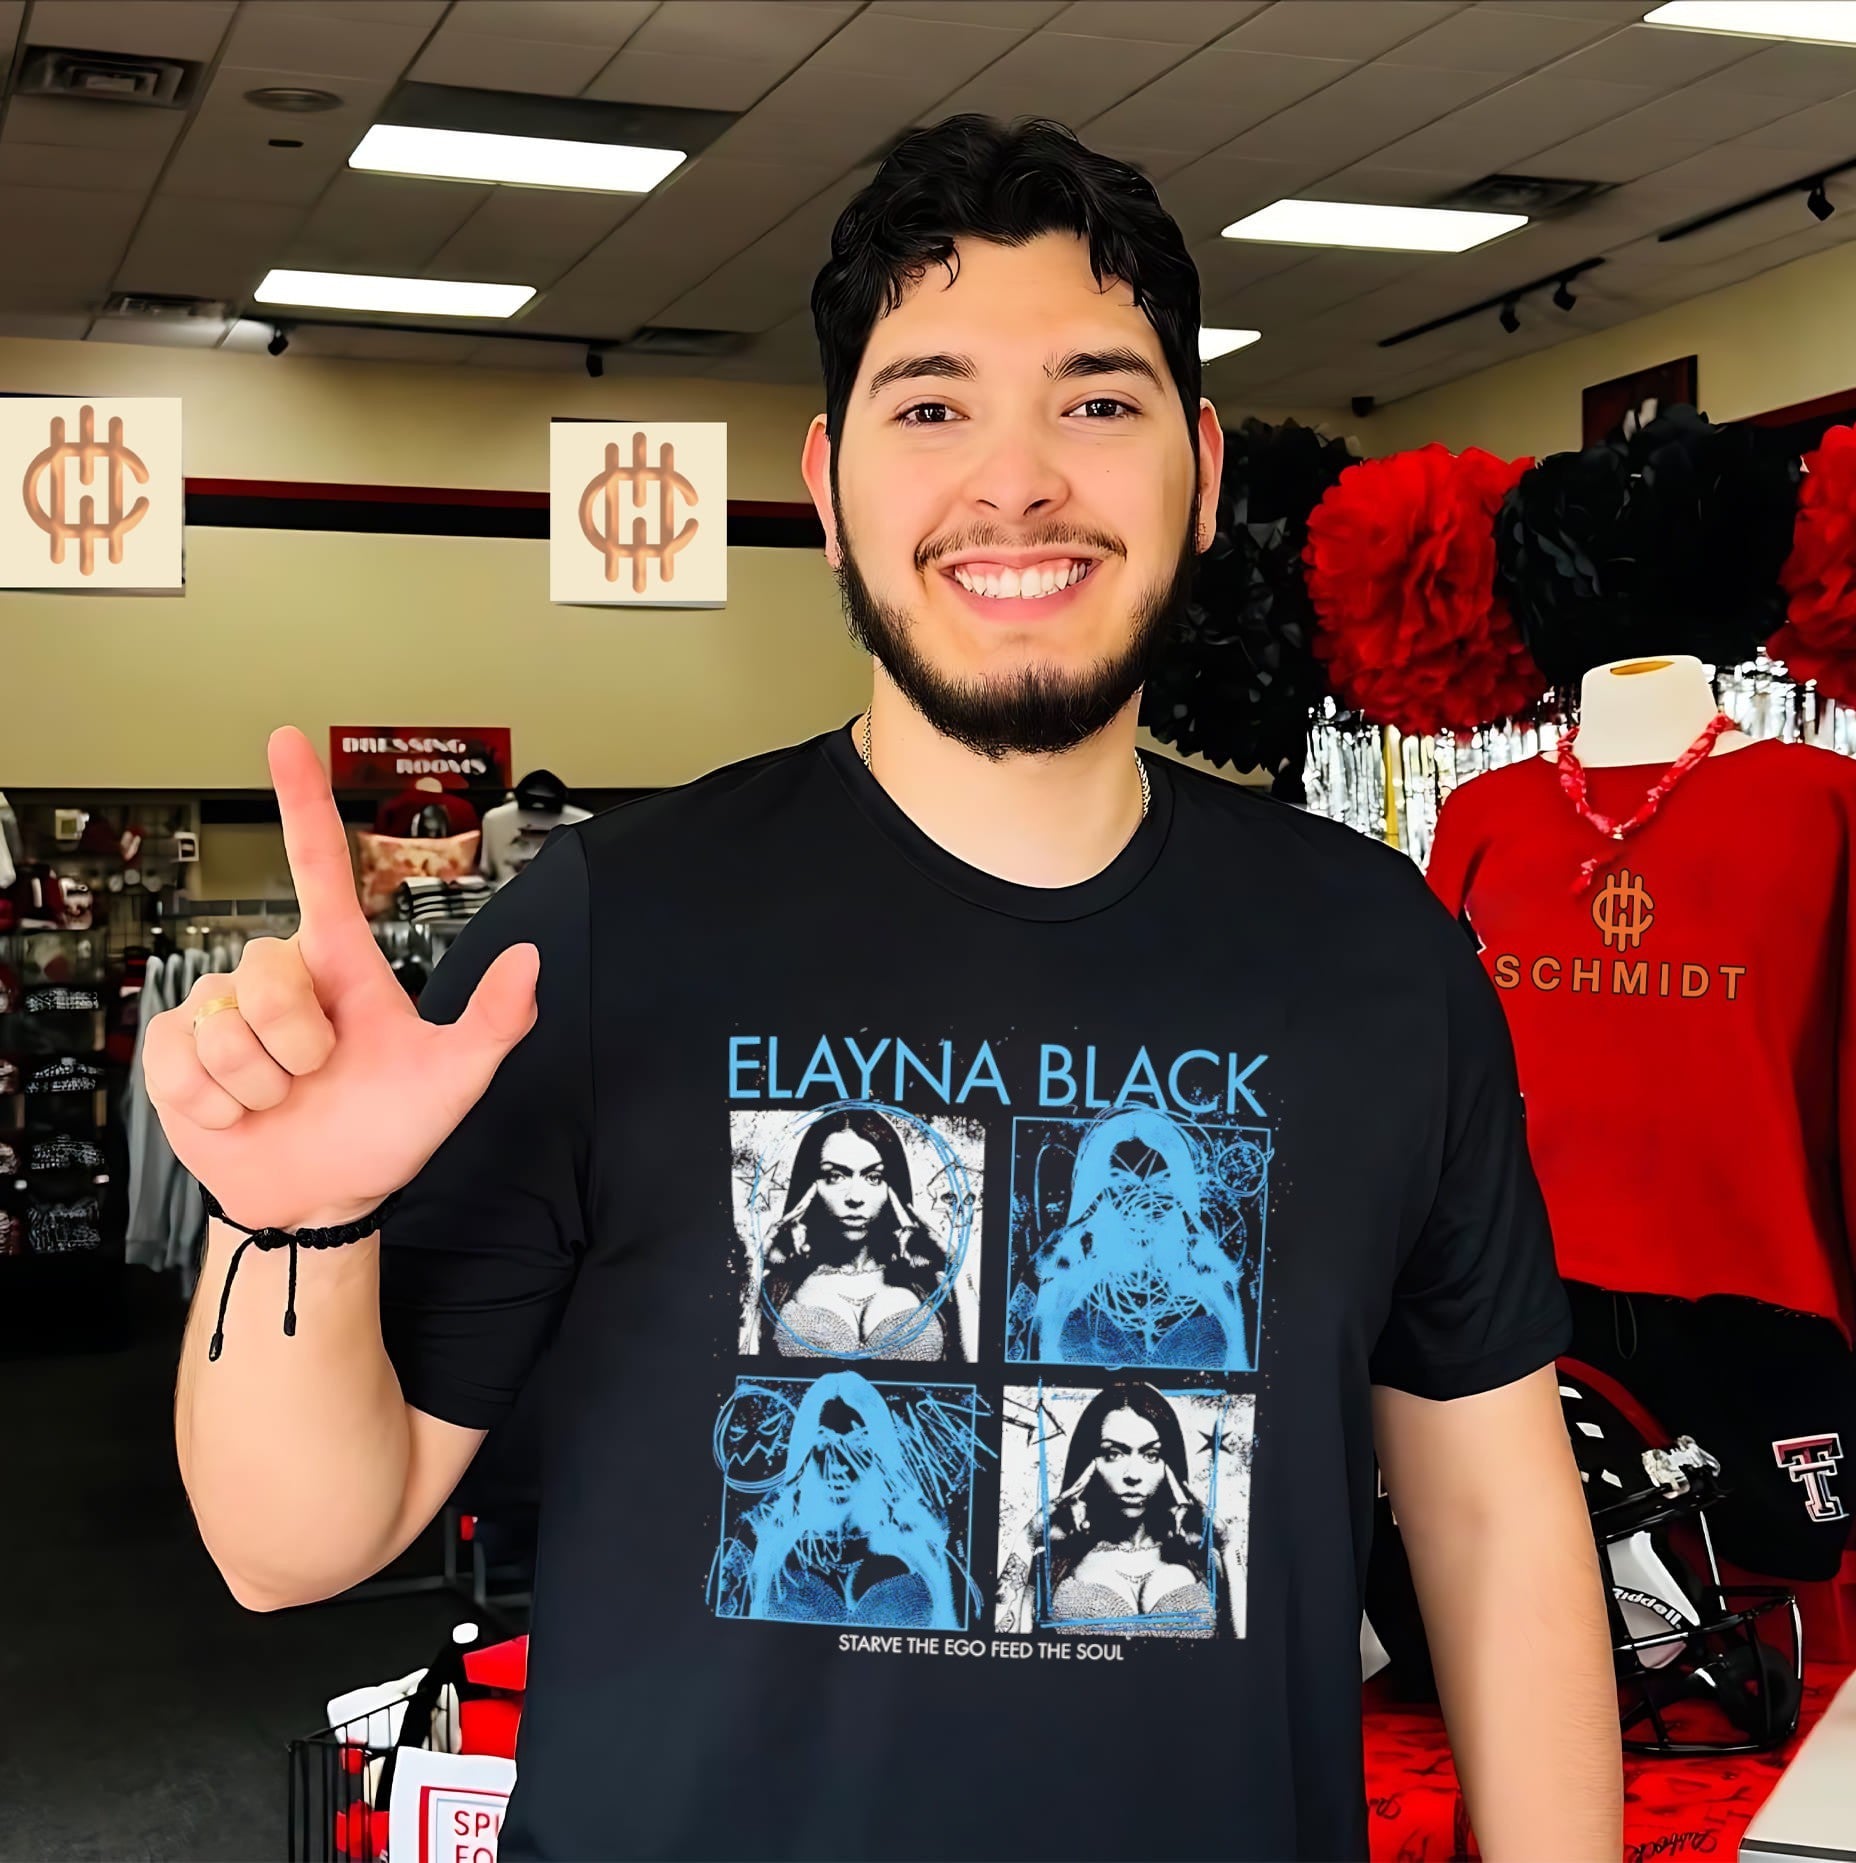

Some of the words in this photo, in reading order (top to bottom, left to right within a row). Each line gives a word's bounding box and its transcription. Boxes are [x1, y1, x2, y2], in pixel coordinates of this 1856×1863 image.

[342, 737, 467, 754] DRESSING
[396, 758, 487, 775] ROOMS
[1494, 953, 1747, 1001] SCHMIDT
[728, 1034, 1011, 1106] ELAYNA
[1038, 1043, 1270, 1118] BLACK
[838, 1633, 903, 1653] STARVE
[906, 1636, 940, 1655] THE
[944, 1639, 986, 1657] EGO
[991, 1640, 1034, 1660] FEED
[1037, 1642, 1072, 1660] THE
[1076, 1643, 1125, 1661] SOUL
